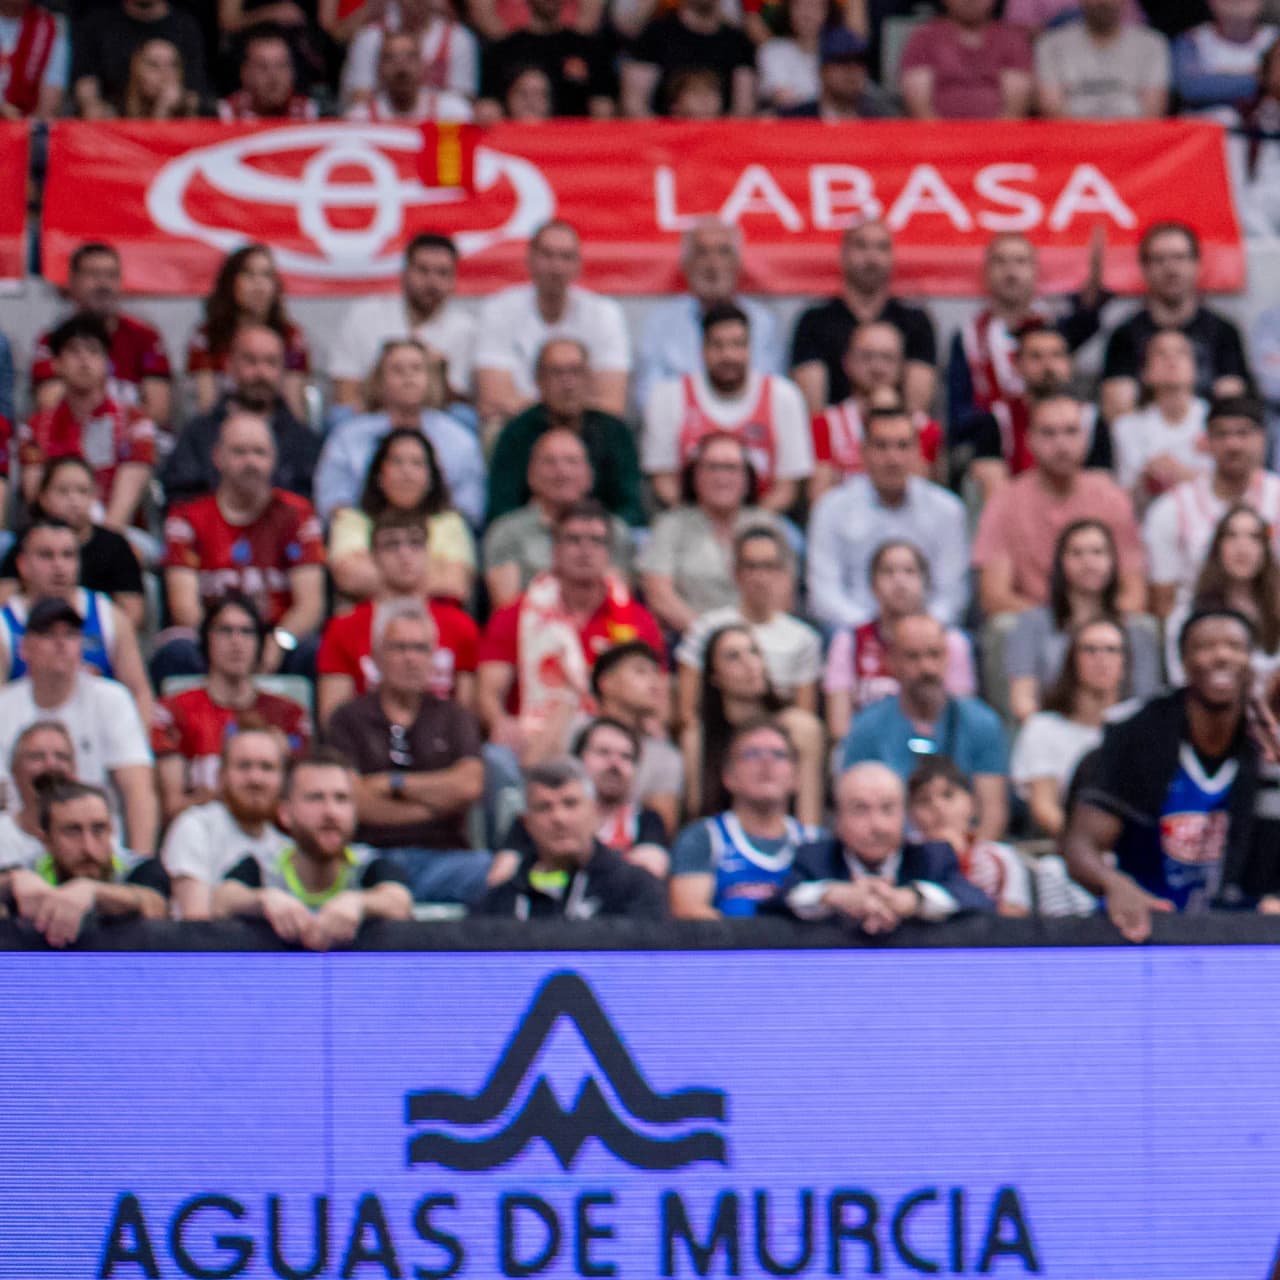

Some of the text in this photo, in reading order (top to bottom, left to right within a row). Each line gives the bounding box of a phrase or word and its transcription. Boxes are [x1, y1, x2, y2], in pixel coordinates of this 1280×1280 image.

[655, 163, 1138, 233] LABASA
[98, 1184, 1039, 1280] AGUAS DE MURCIA
